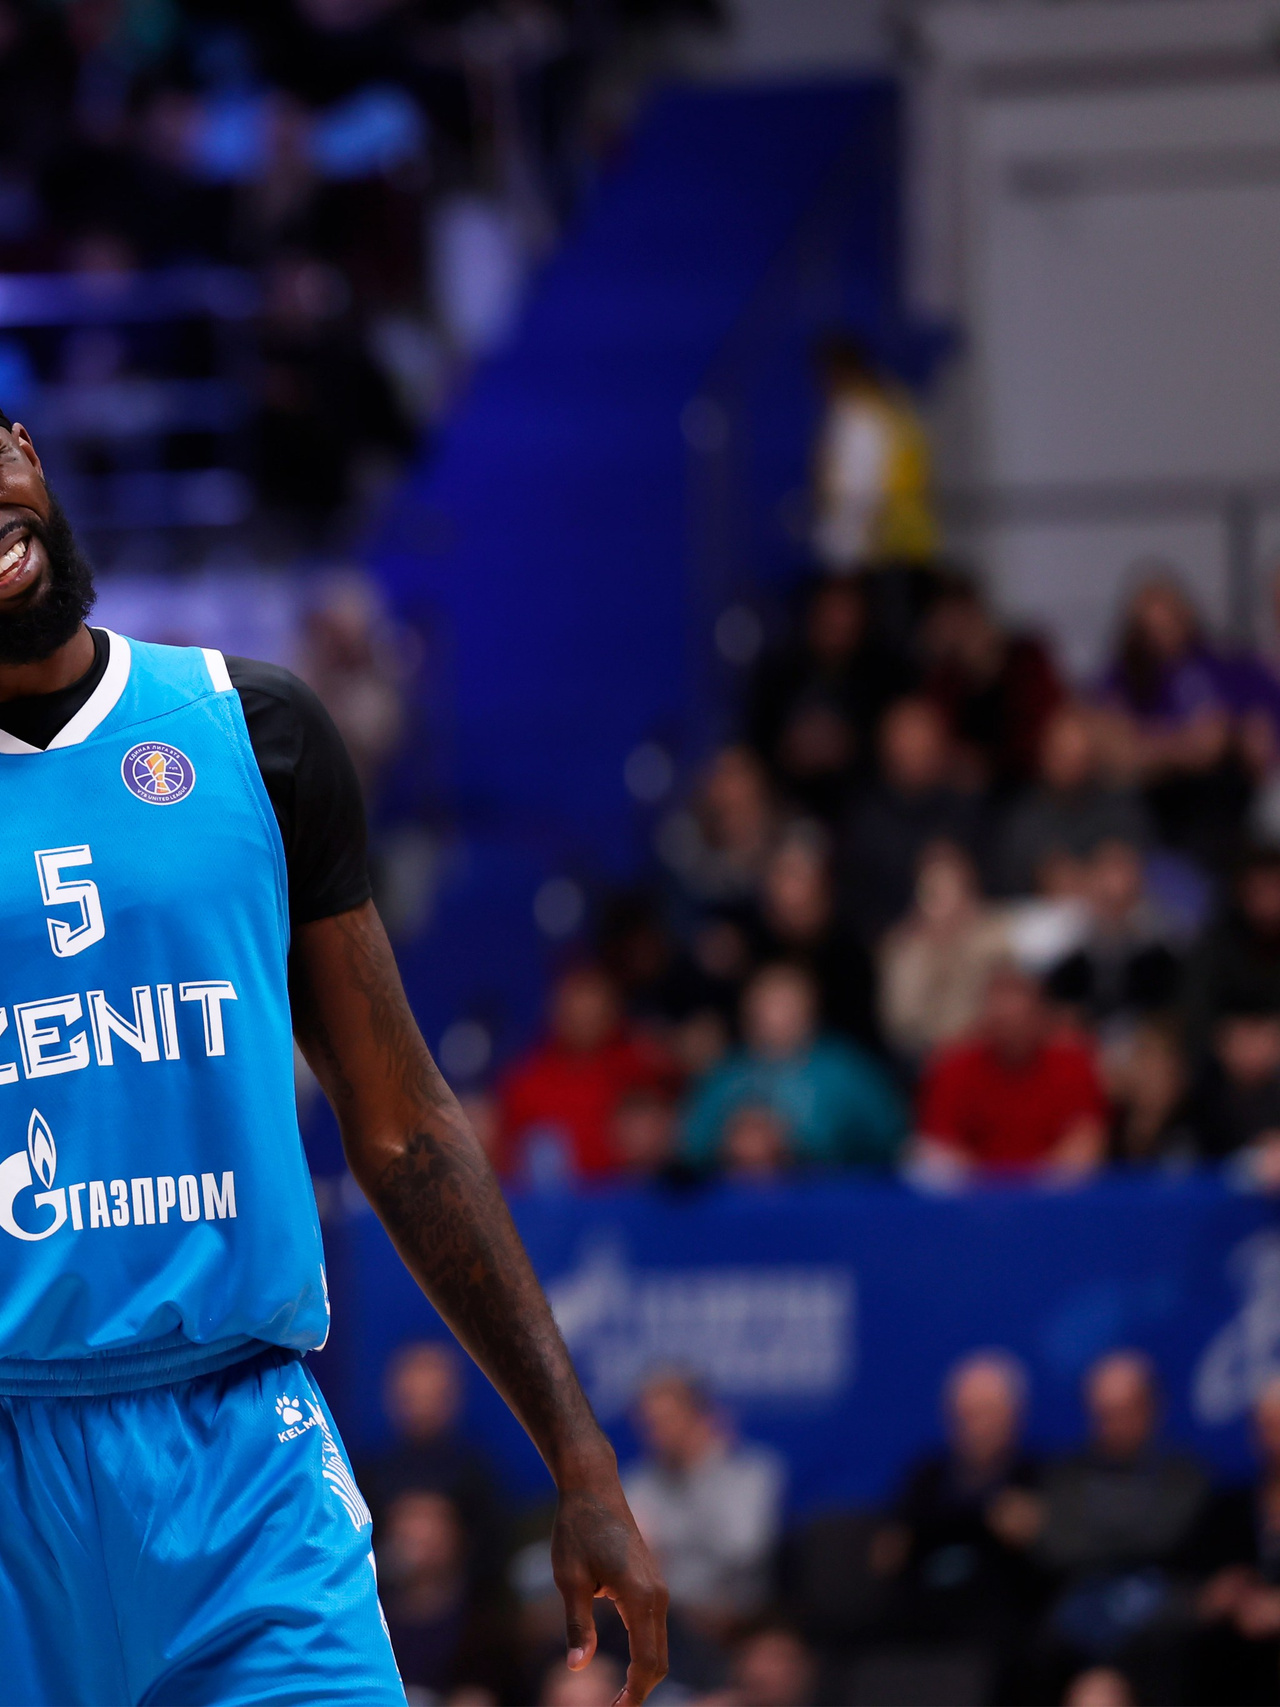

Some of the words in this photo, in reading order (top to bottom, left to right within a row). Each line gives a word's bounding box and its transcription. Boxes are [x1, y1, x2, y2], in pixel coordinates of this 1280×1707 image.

[170, 786, 188, 800] LEAGUE
[34, 844, 105, 958] 5
[66, 1171, 237, 1231] ГАЗПРОМ
[277, 1416, 324, 1443] KELM
